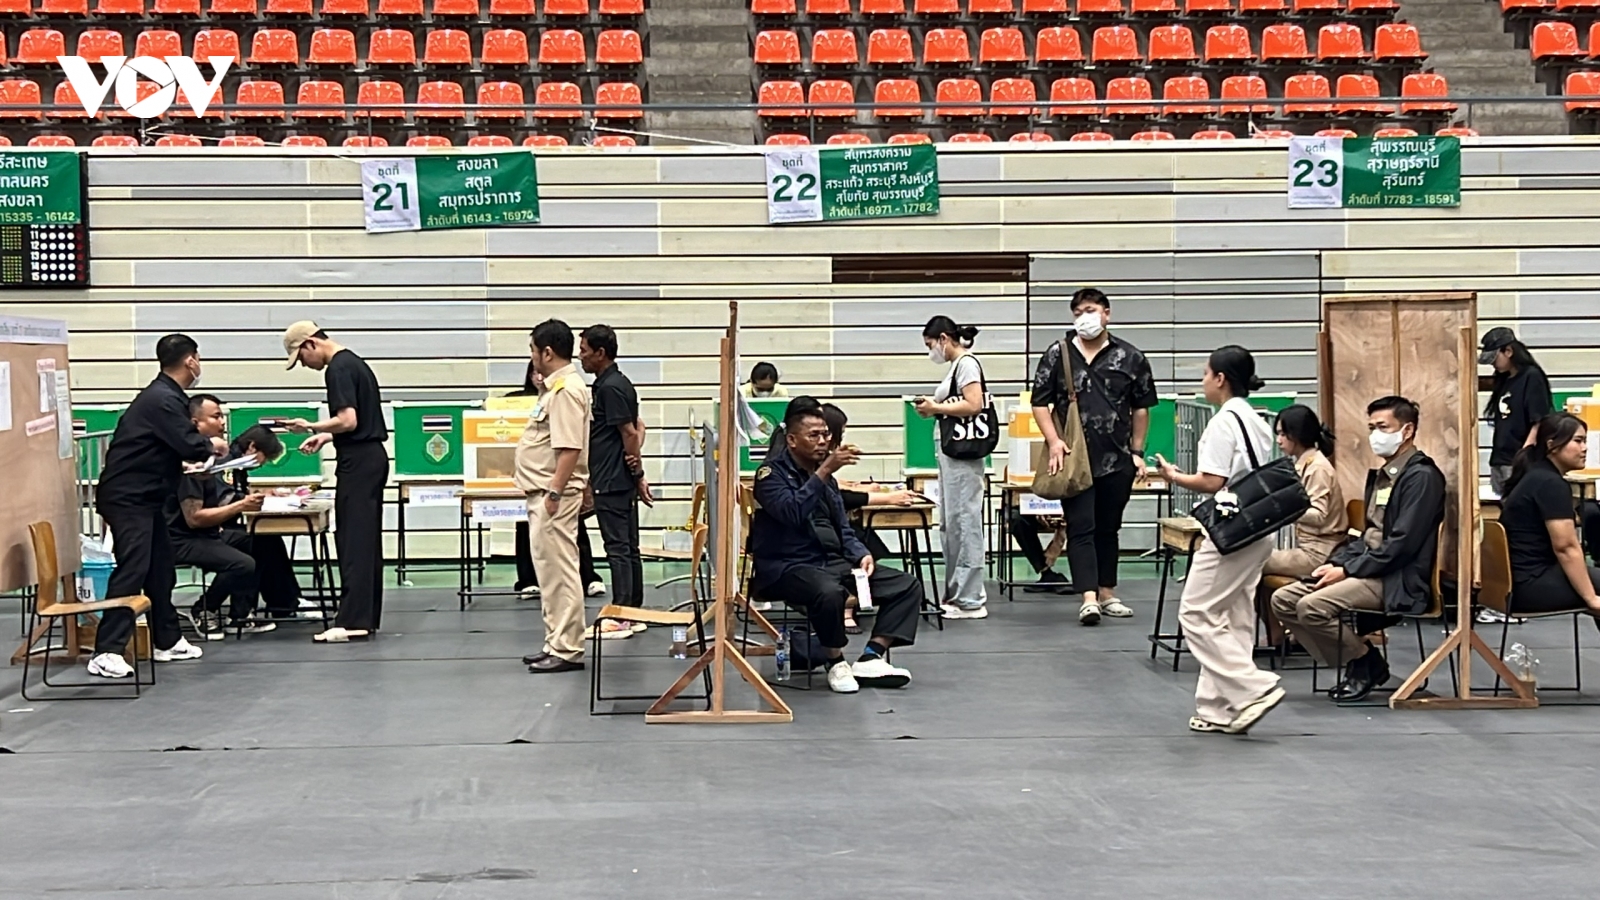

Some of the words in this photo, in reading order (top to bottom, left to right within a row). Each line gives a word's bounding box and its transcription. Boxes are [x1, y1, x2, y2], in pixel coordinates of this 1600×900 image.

[844, 147, 912, 162] สมุทรสงคราม
[1370, 138, 1436, 157] สุพรรณบุรี
[456, 157, 498, 171] สงขลา
[782, 155, 803, 170] ชุดที่
[1366, 154, 1440, 174] สุราษฎร์ธานี
[378, 163, 400, 179] ชุดที่
[1293, 159, 1338, 187] 23
[0, 175, 49, 188] กลนคร
[465, 175, 493, 191] สตูล
[772, 173, 818, 203] 22
[825, 175, 863, 190] สระแก้ว
[866, 173, 897, 189] สระบุรี
[899, 170, 935, 187] สิงห์บุรี
[1382, 171, 1426, 190] สุรินทร์
[0, 194, 44, 208] สงขลา
[371, 182, 409, 211] 21
[438, 190, 522, 210] สมุทรปราการ
[836, 189, 869, 205] สุโขทัย
[872, 184, 925, 203] สุพรรณบุรี
[1348, 191, 1381, 205] ลำดับที่
[1384, 194, 1413, 204] 17783
[1424, 194, 1455, 204] 18591
[0, 212, 34, 222] 15335
[45, 211, 76, 221] 16142
[829, 203, 861, 217] ลำดับที่
[864, 204, 892, 215] 16971
[903, 202, 933, 213] 17782
[427, 212, 459, 226] ลำดับที่
[462, 213, 492, 224] 16143
[503, 210, 534, 221] 16970
